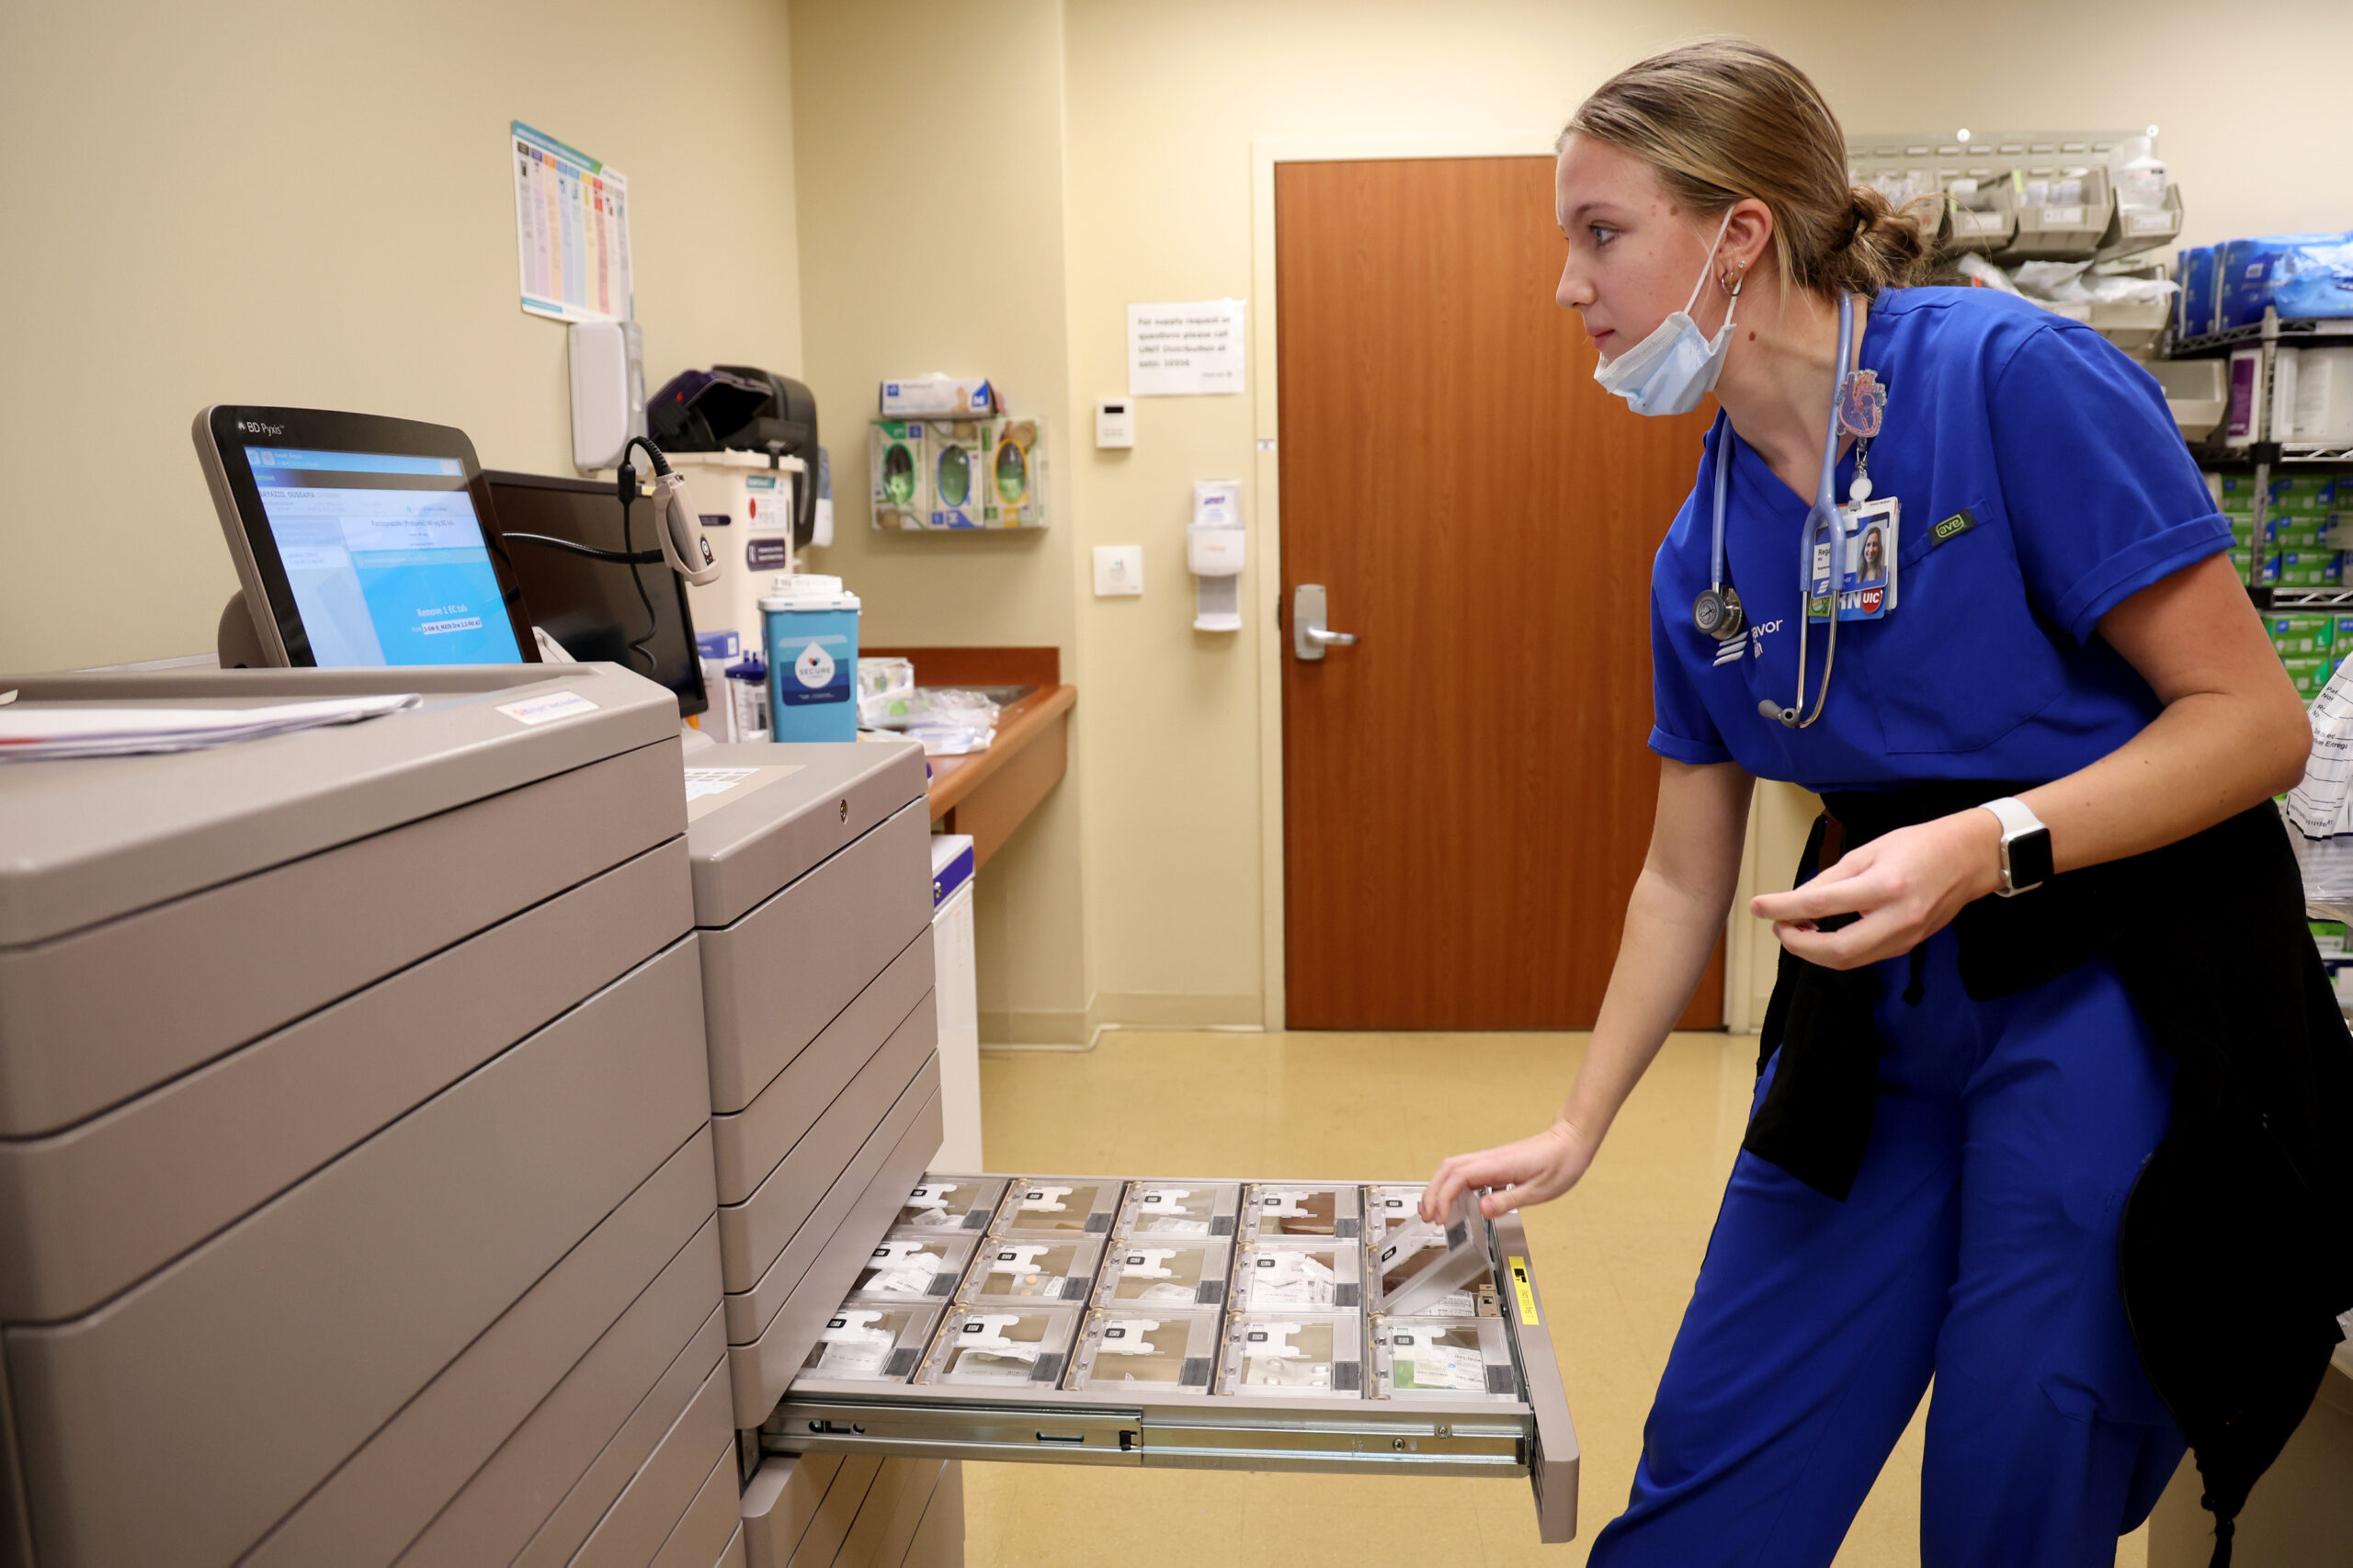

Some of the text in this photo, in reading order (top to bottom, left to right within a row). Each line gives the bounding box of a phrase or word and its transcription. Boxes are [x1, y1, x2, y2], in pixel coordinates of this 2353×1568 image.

[246, 422, 261, 433] BD
[1938, 518, 1962, 535] ave
[1862, 593, 1881, 604] UIC
[1751, 619, 1783, 639] avor
[799, 667, 831, 676] SECURE
